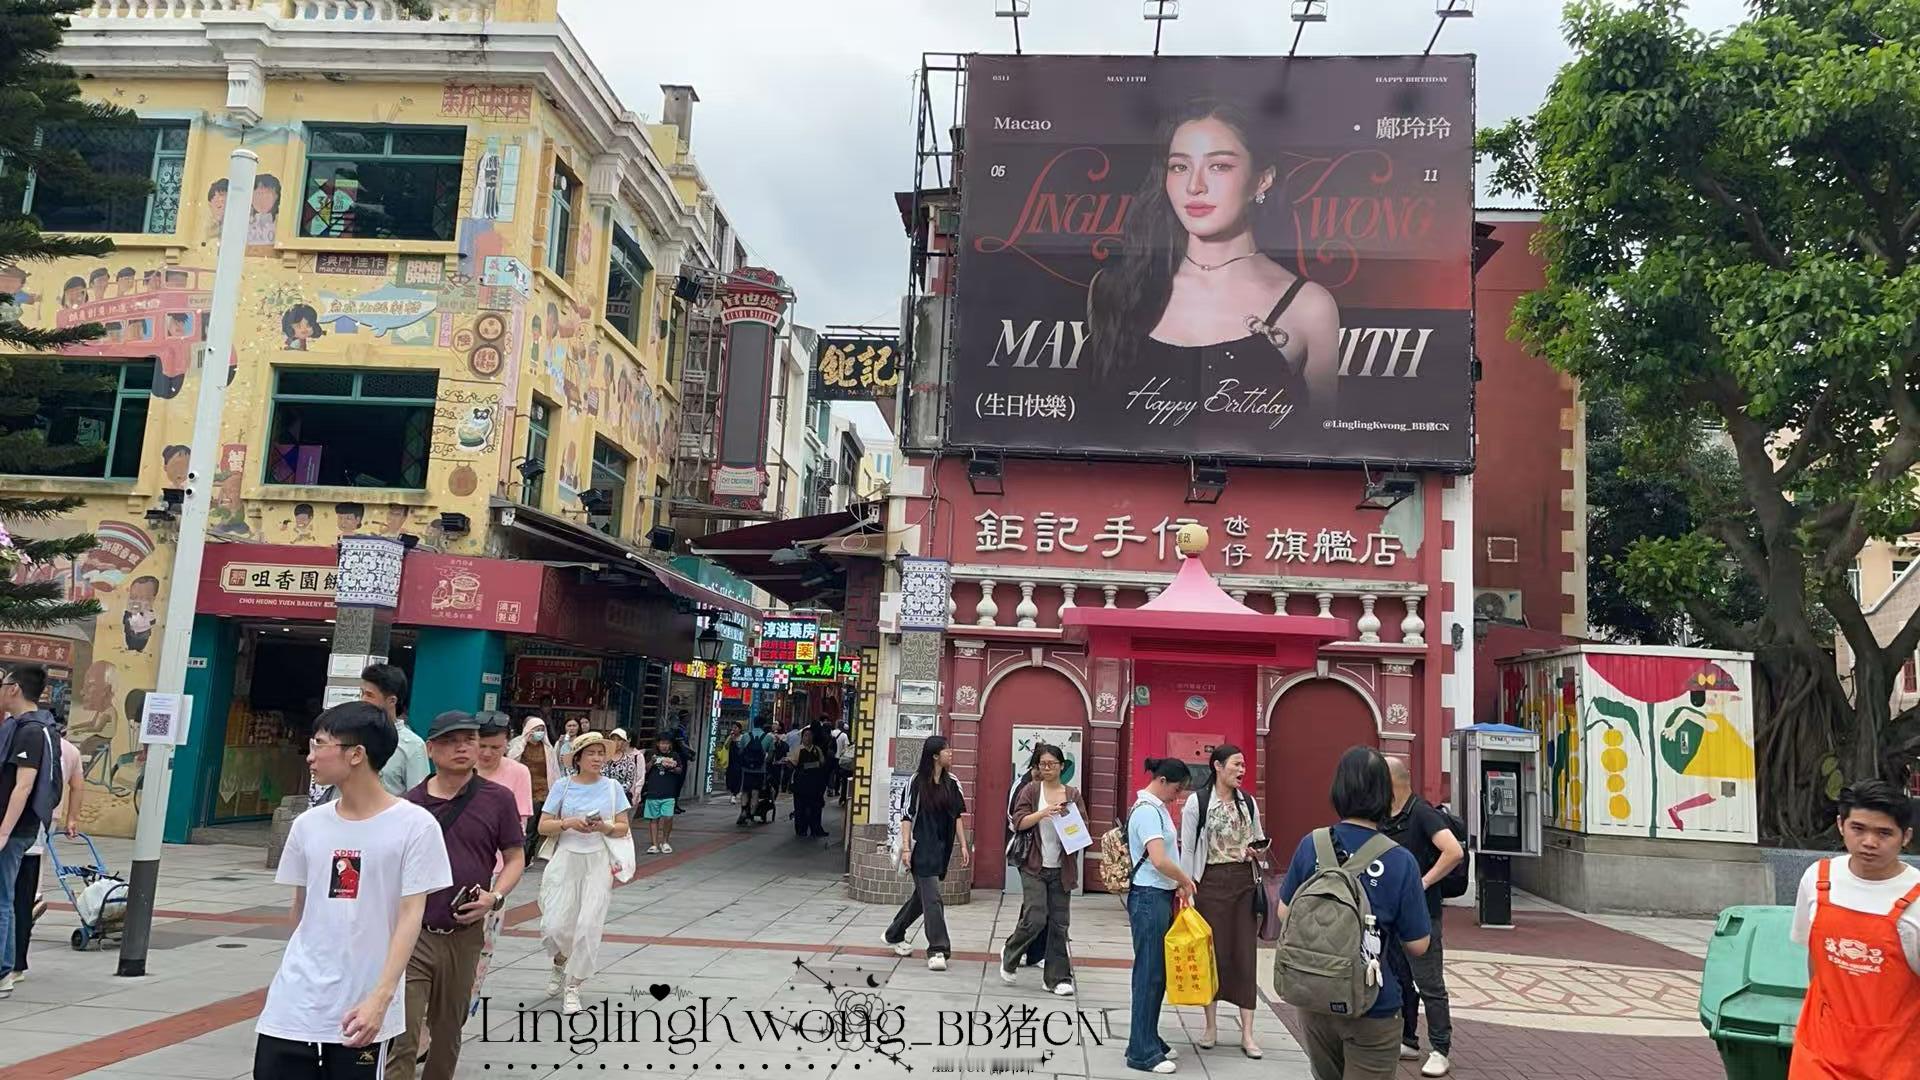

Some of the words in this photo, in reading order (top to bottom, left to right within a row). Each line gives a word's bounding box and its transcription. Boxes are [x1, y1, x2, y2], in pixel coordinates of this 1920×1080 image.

[993, 116, 1052, 130] Macao
[1376, 116, 1452, 139] 鄺玲玲
[990, 164, 1006, 177] 05
[1423, 169, 1438, 182] 11
[987, 319, 1091, 369] MAY
[818, 343, 898, 388] 鉅記
[975, 393, 1076, 421] (生日快樂)
[1126, 376, 1197, 427] Happy
[1204, 378, 1294, 430] Birthday
[1265, 528, 1402, 566] 旗艦店
[239, 597, 255, 605] CHOI
[256, 598, 278, 606] HEONG
[279, 599, 296, 607] YUEN
[297, 600, 323, 608] BAKERY
[763, 621, 816, 639] 淳溢藥房
